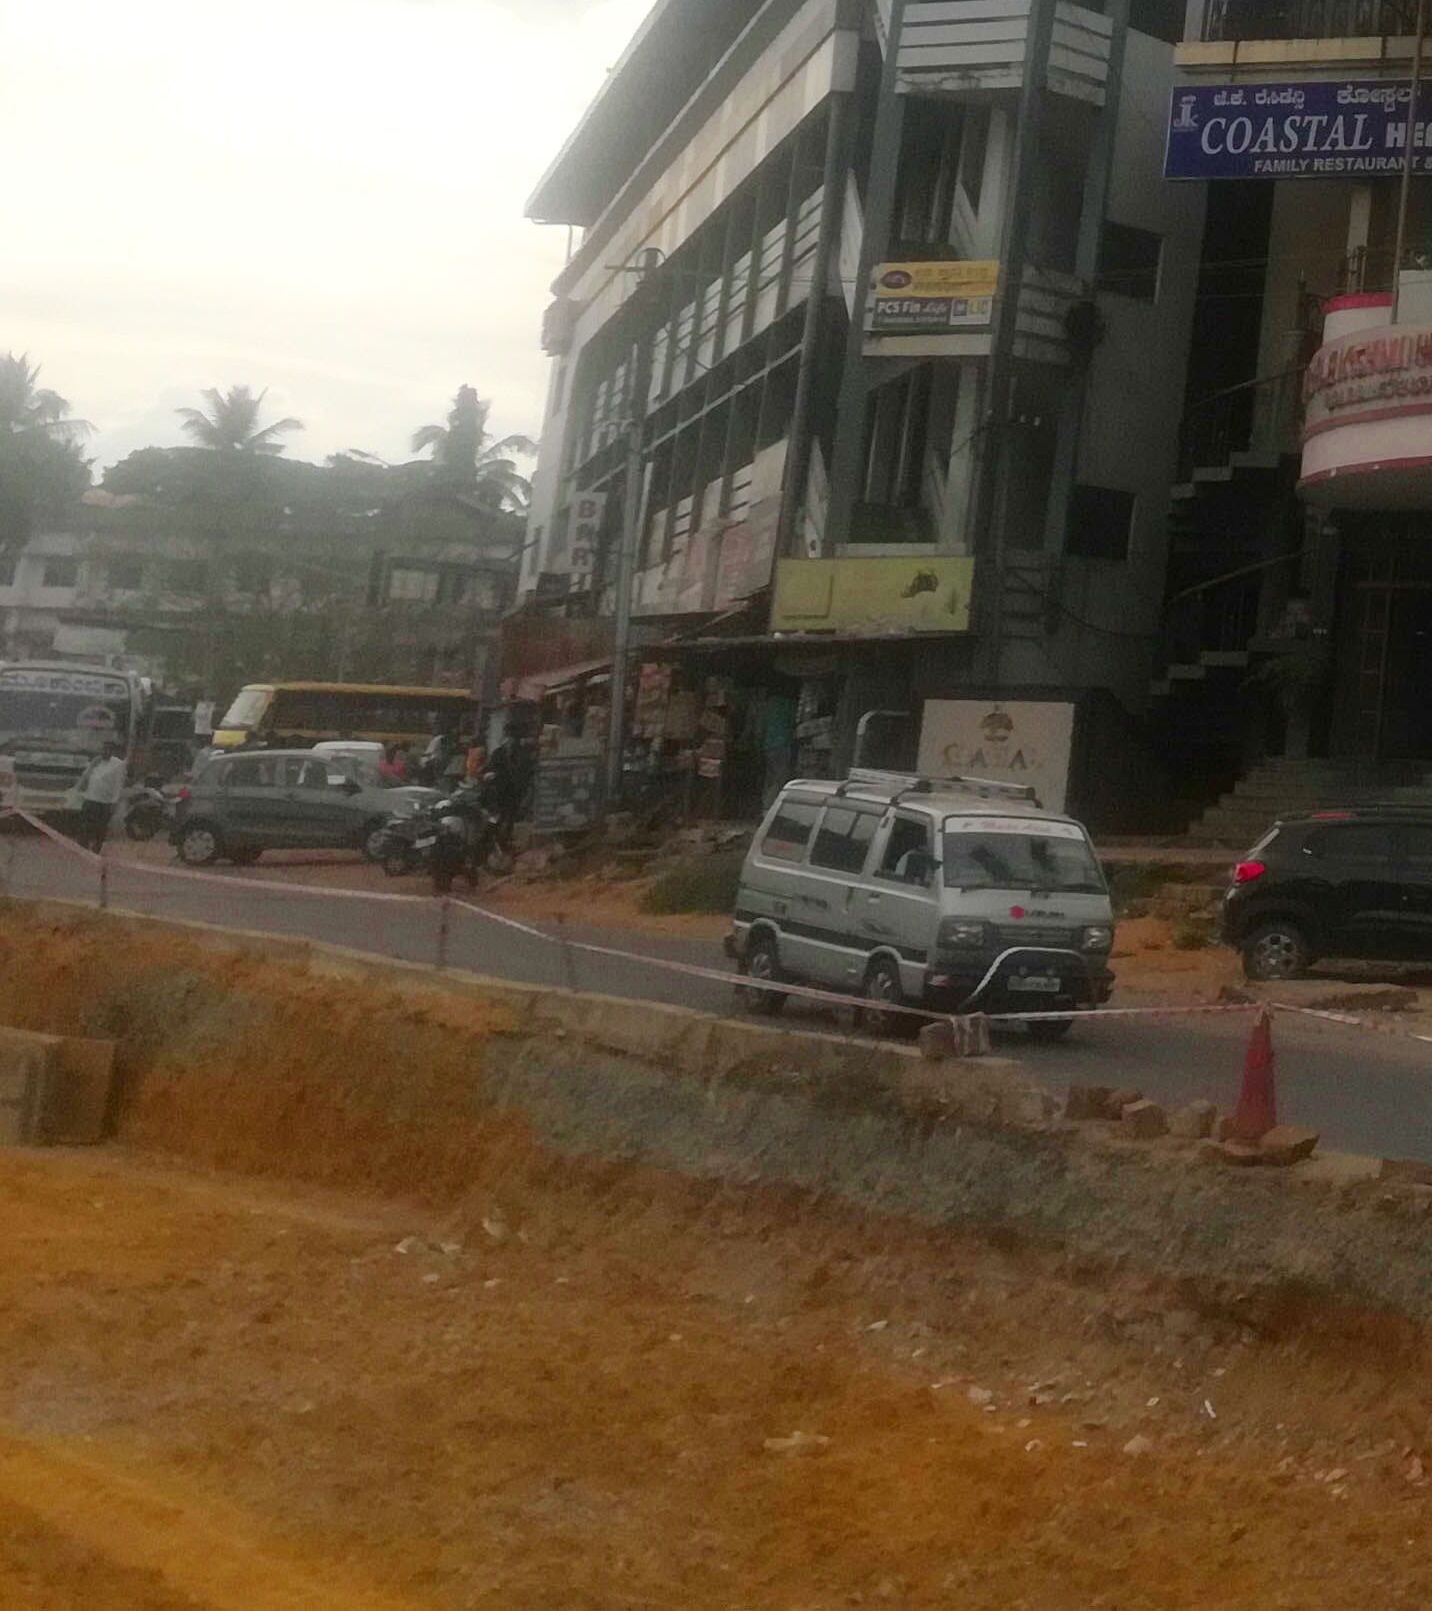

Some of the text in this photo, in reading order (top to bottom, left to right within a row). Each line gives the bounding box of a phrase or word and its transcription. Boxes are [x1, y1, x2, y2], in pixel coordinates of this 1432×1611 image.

[1200, 114, 1375, 155] COASTAL
[1254, 158, 1307, 174] FAMILY
[1313, 155, 1420, 172] RESTAURANT
